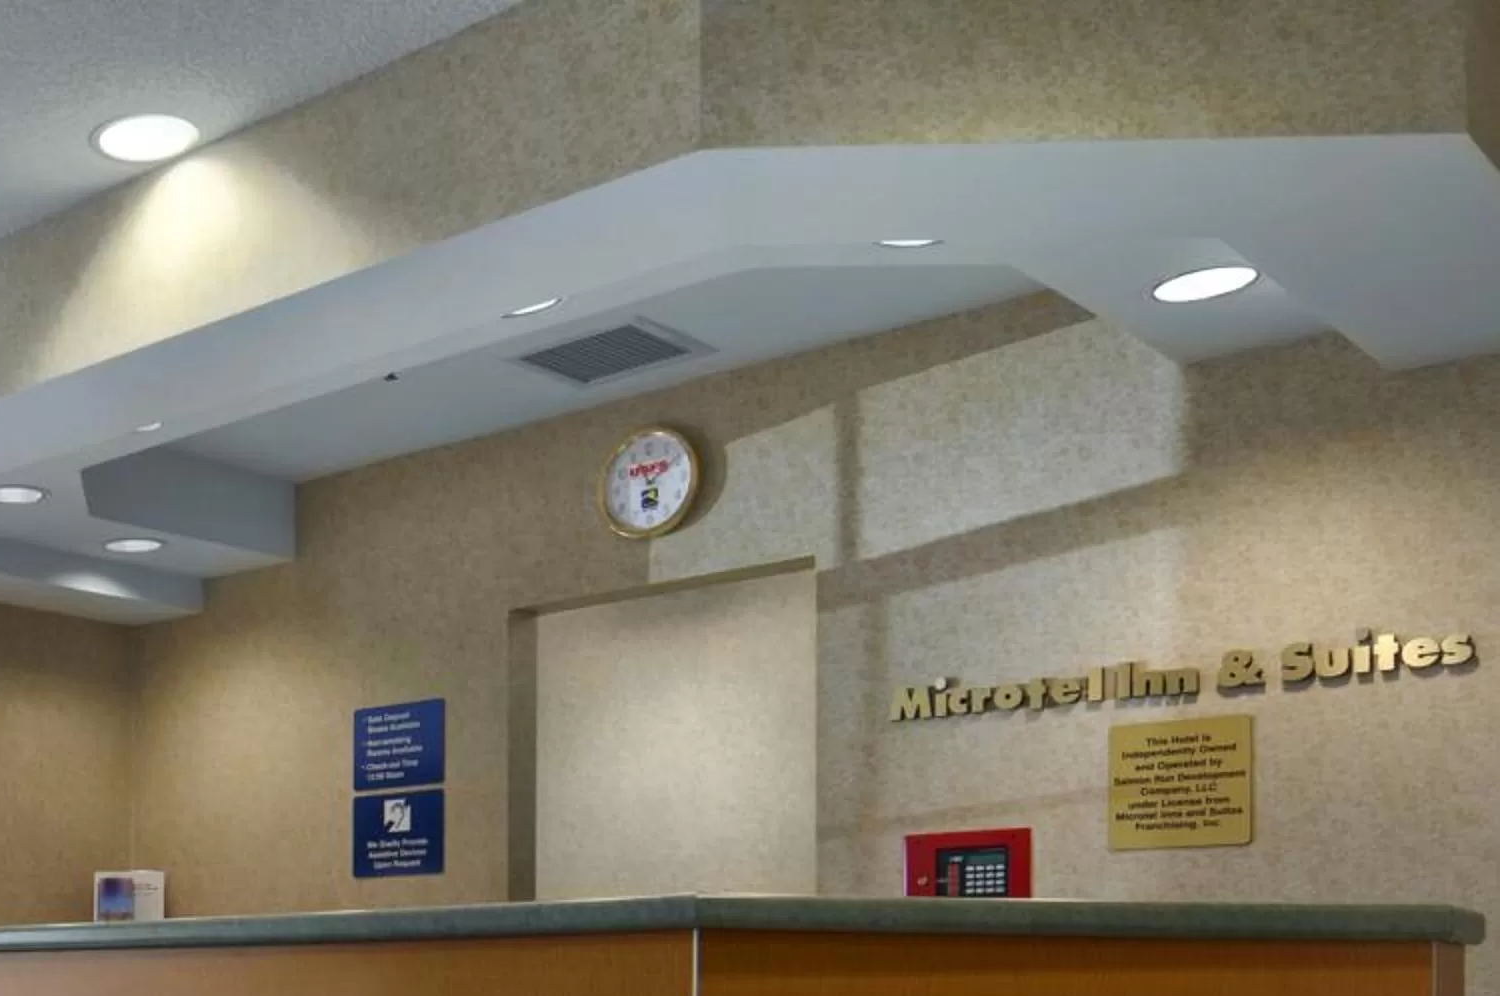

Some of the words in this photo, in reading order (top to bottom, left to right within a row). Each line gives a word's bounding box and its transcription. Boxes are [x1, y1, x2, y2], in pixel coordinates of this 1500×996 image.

[889, 665, 1105, 723] Microtel
[1115, 661, 1201, 701] Inn
[1216, 649, 1266, 688] &
[1281, 631, 1476, 682] Suites
[1145, 737, 1169, 747] This
[1171, 734, 1199, 745] Hotel
[1201, 733, 1212, 743] is
[1121, 747, 1196, 761] Independently
[1199, 742, 1237, 754] Owned
[1134, 763, 1155, 772] and
[1157, 759, 1207, 771] Operated
[1209, 757, 1223, 768] by
[1177, 769, 1247, 782] Development
[1161, 798, 1203, 809] License
[1205, 796, 1231, 805] from
[1185, 808, 1207, 818] and
[1209, 806, 1244, 817] Suites
